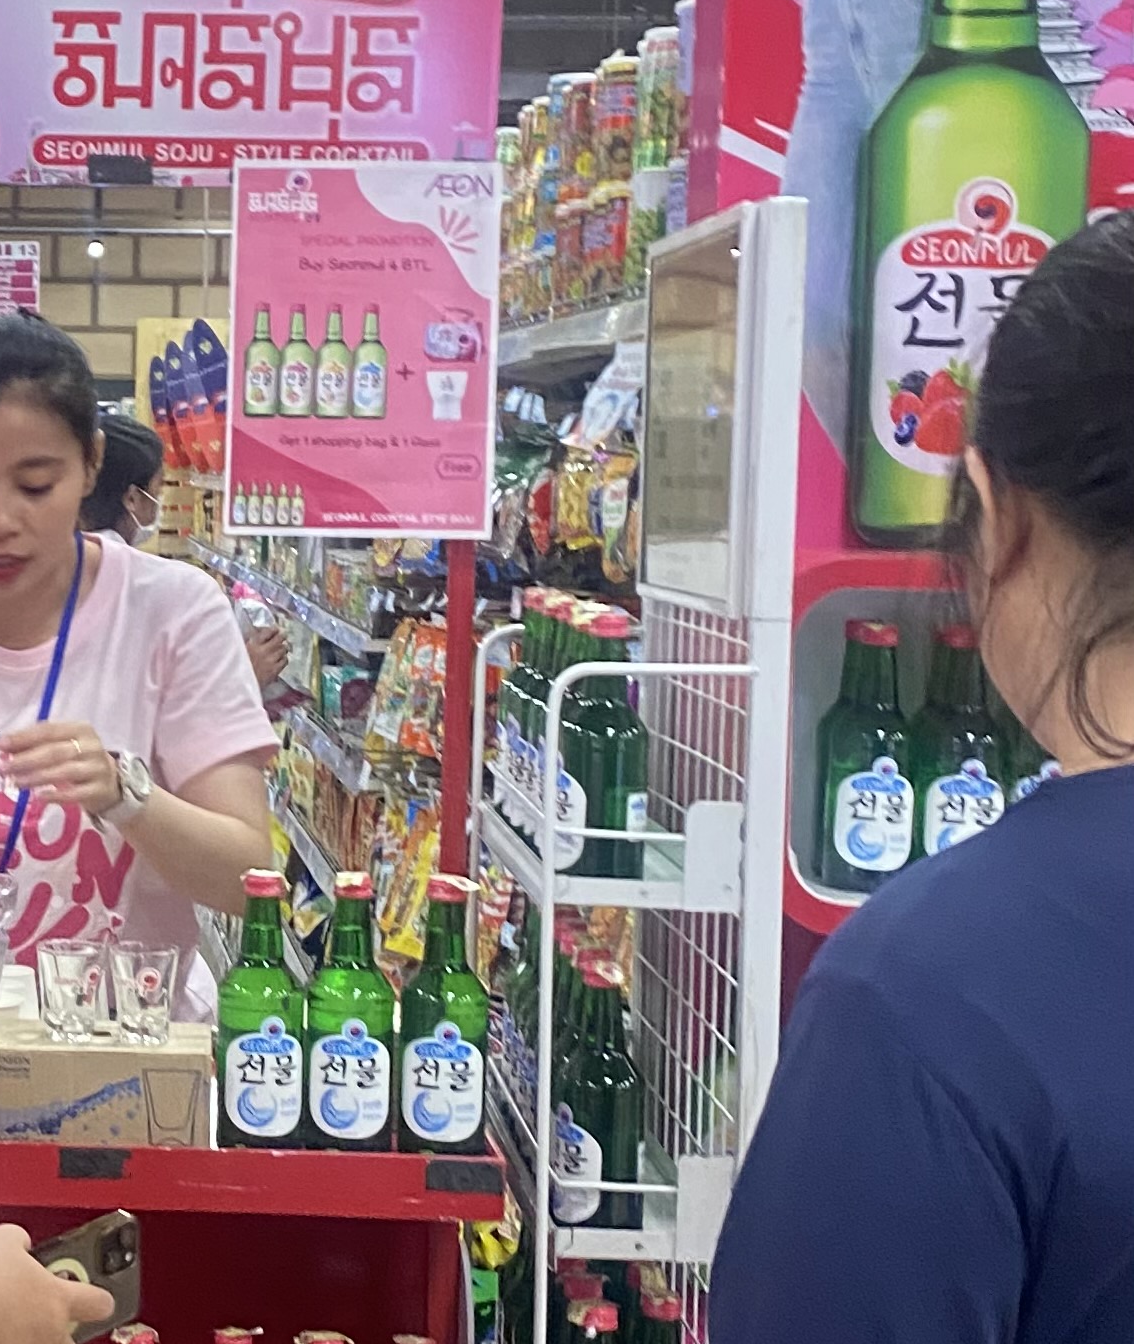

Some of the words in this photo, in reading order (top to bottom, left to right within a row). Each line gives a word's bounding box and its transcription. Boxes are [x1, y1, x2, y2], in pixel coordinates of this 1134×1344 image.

[155, 143, 213, 162] SOJU
[234, 144, 303, 161] STYLE
[909, 234, 1037, 264] SEONMUL
[237, 1054, 296, 1086] 선물
[321, 1055, 381, 1089] 선물
[413, 1059, 474, 1092] 선물
